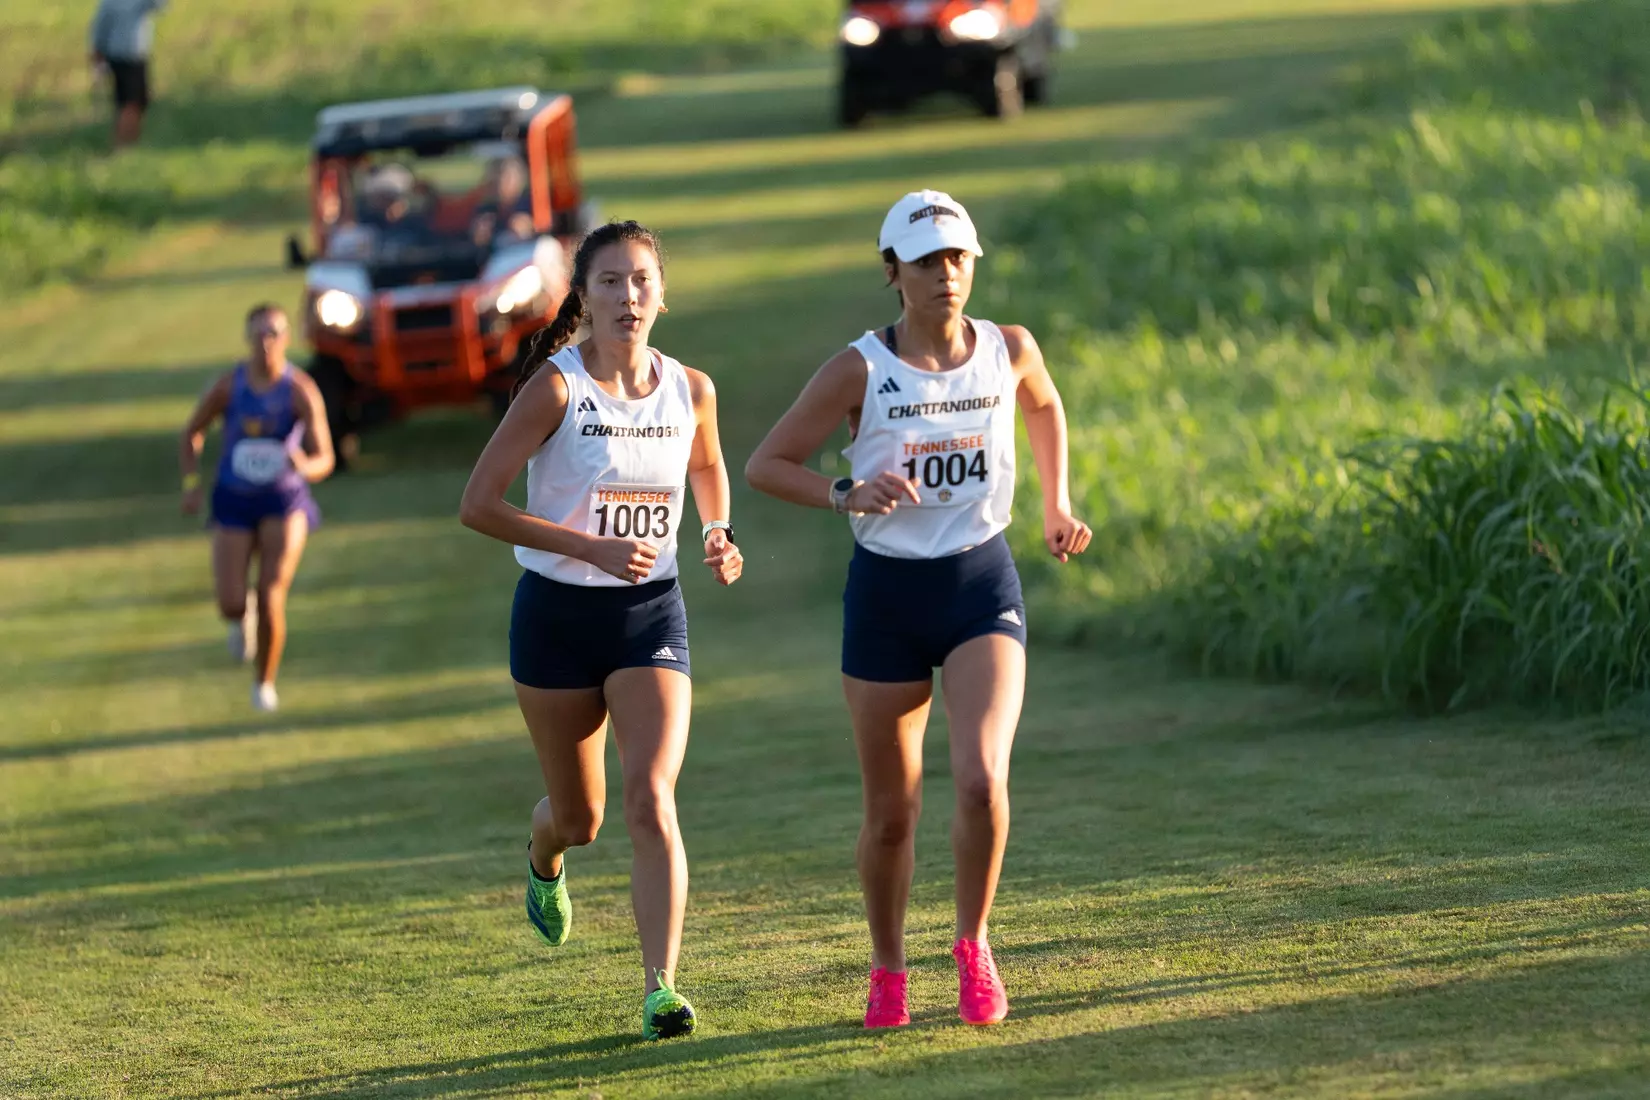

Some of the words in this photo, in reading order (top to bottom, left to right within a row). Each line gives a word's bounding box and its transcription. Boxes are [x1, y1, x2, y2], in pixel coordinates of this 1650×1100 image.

[888, 395, 1001, 419] CHATTANOOGA
[581, 424, 680, 438] CHATTANOOGA
[903, 434, 984, 456] TENNESSEE
[902, 449, 988, 488] 1004
[597, 489, 672, 503] TENNESSEE
[595, 504, 670, 538] 1003
